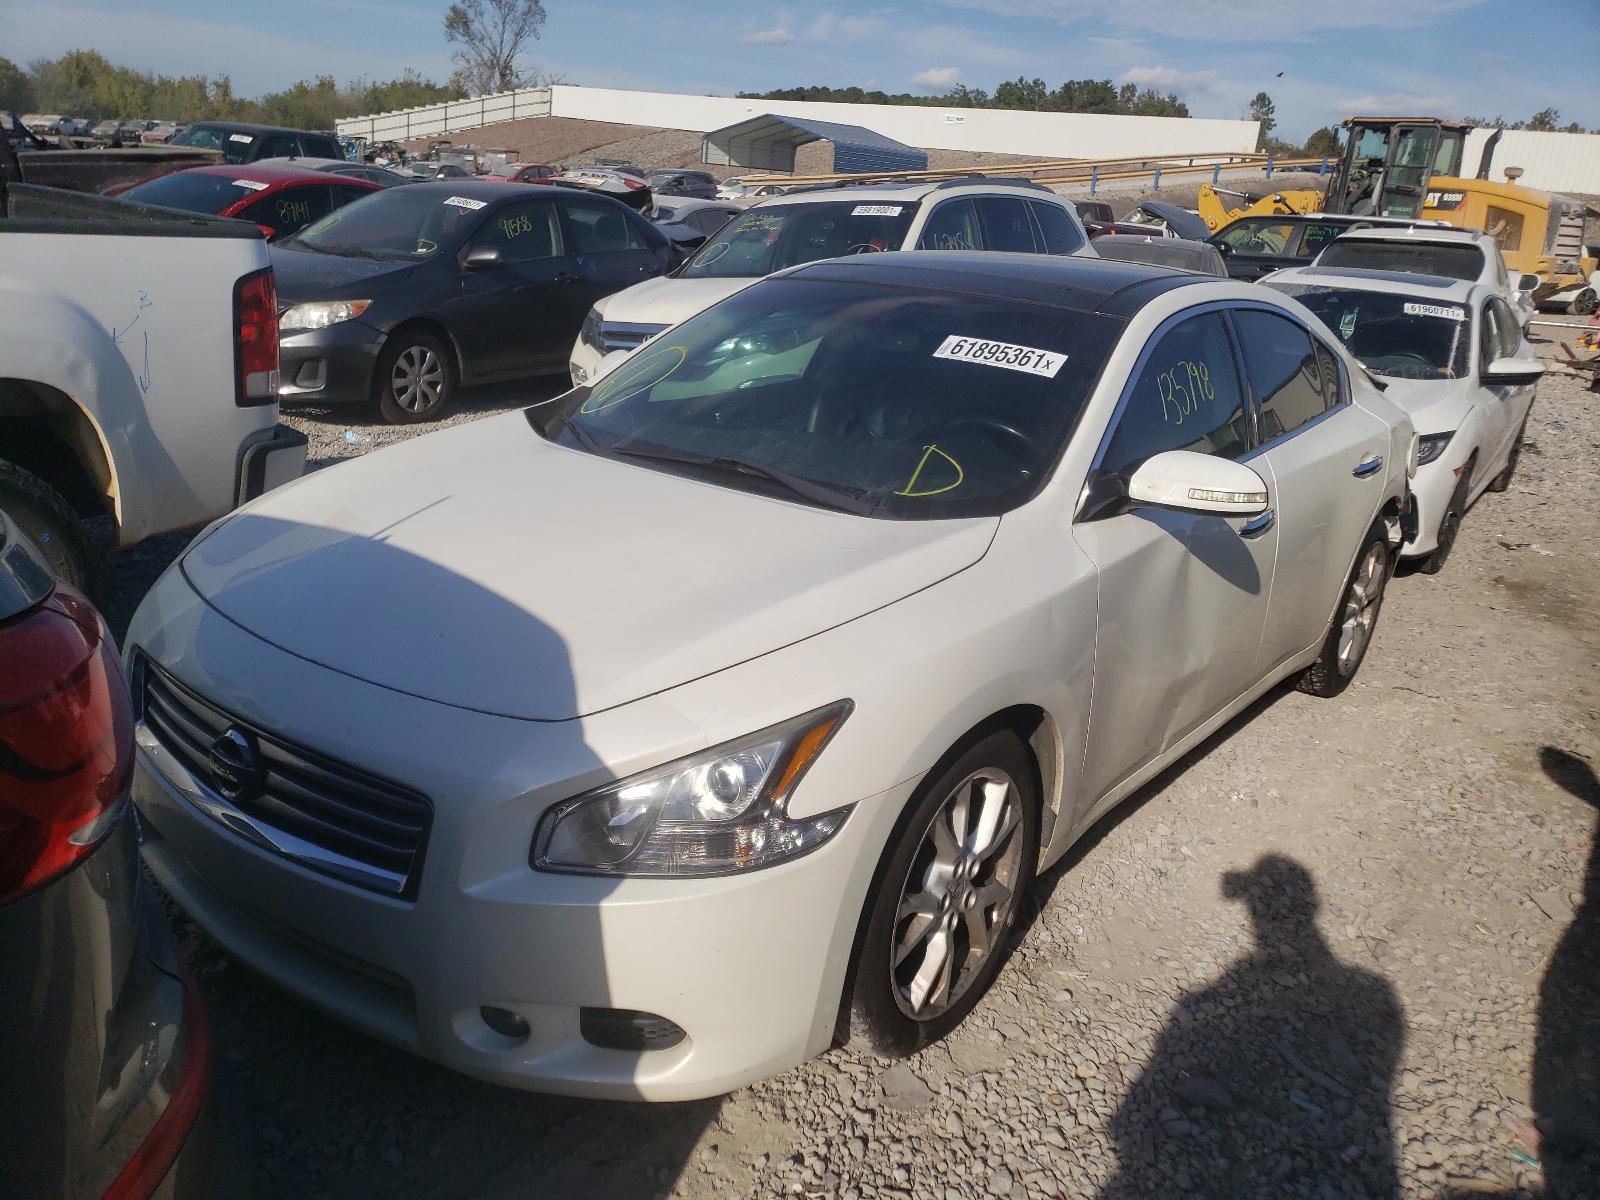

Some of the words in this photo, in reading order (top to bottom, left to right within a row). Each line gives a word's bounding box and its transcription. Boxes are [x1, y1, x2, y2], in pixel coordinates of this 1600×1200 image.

[1424, 192, 1442, 207] AT
[1157, 360, 1215, 425] 135798
[892, 444, 964, 497] D
